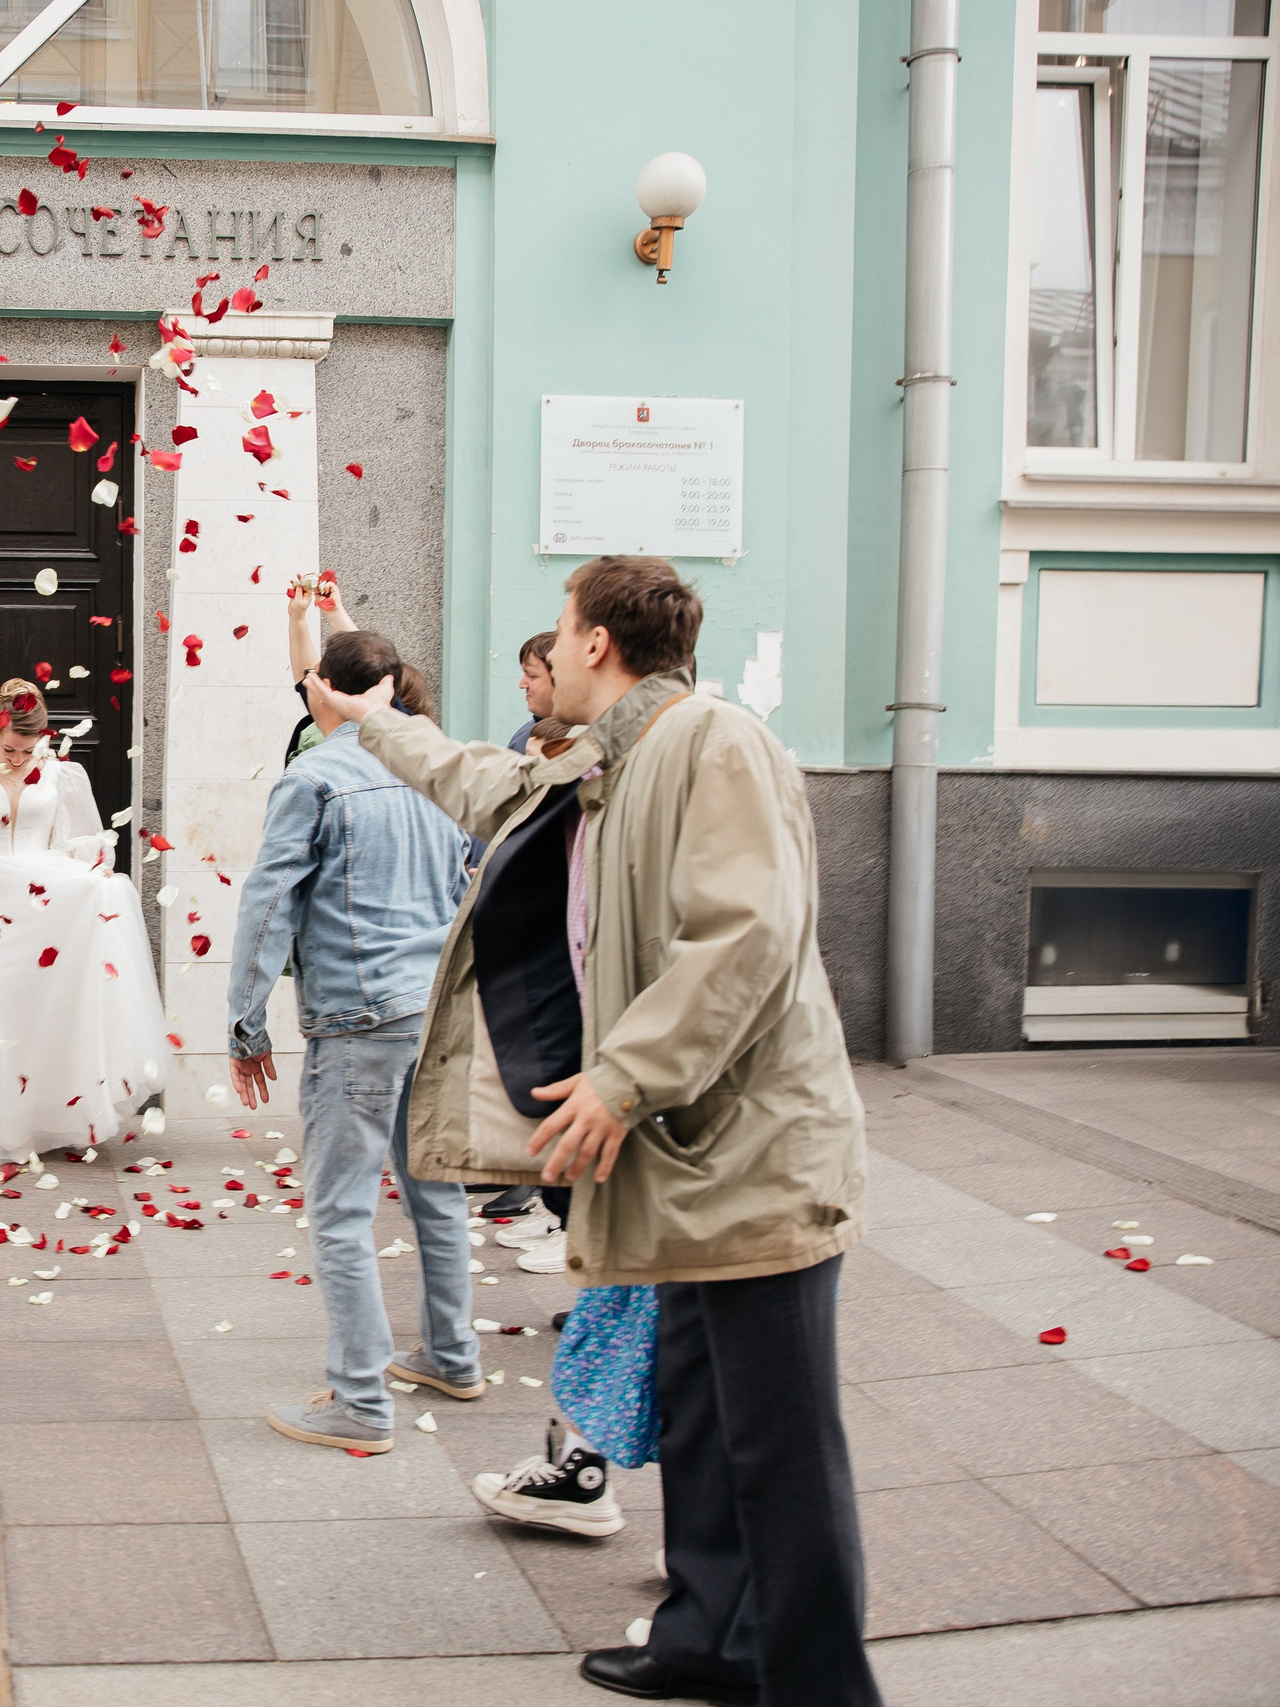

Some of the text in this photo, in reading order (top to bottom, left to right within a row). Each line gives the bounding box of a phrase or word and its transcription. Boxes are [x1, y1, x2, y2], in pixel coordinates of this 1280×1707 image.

[572, 438, 610, 449] Дворец
[612, 438, 691, 451] бракосочетания
[693, 441, 706, 450] №
[608, 463, 677, 473] РЕЖИМ РАБОТЫ
[681, 477, 700, 486] 9:00
[681, 491, 700, 500] 9:00
[680, 504, 700, 513] 9:00
[675, 518, 700, 527] 00:00
